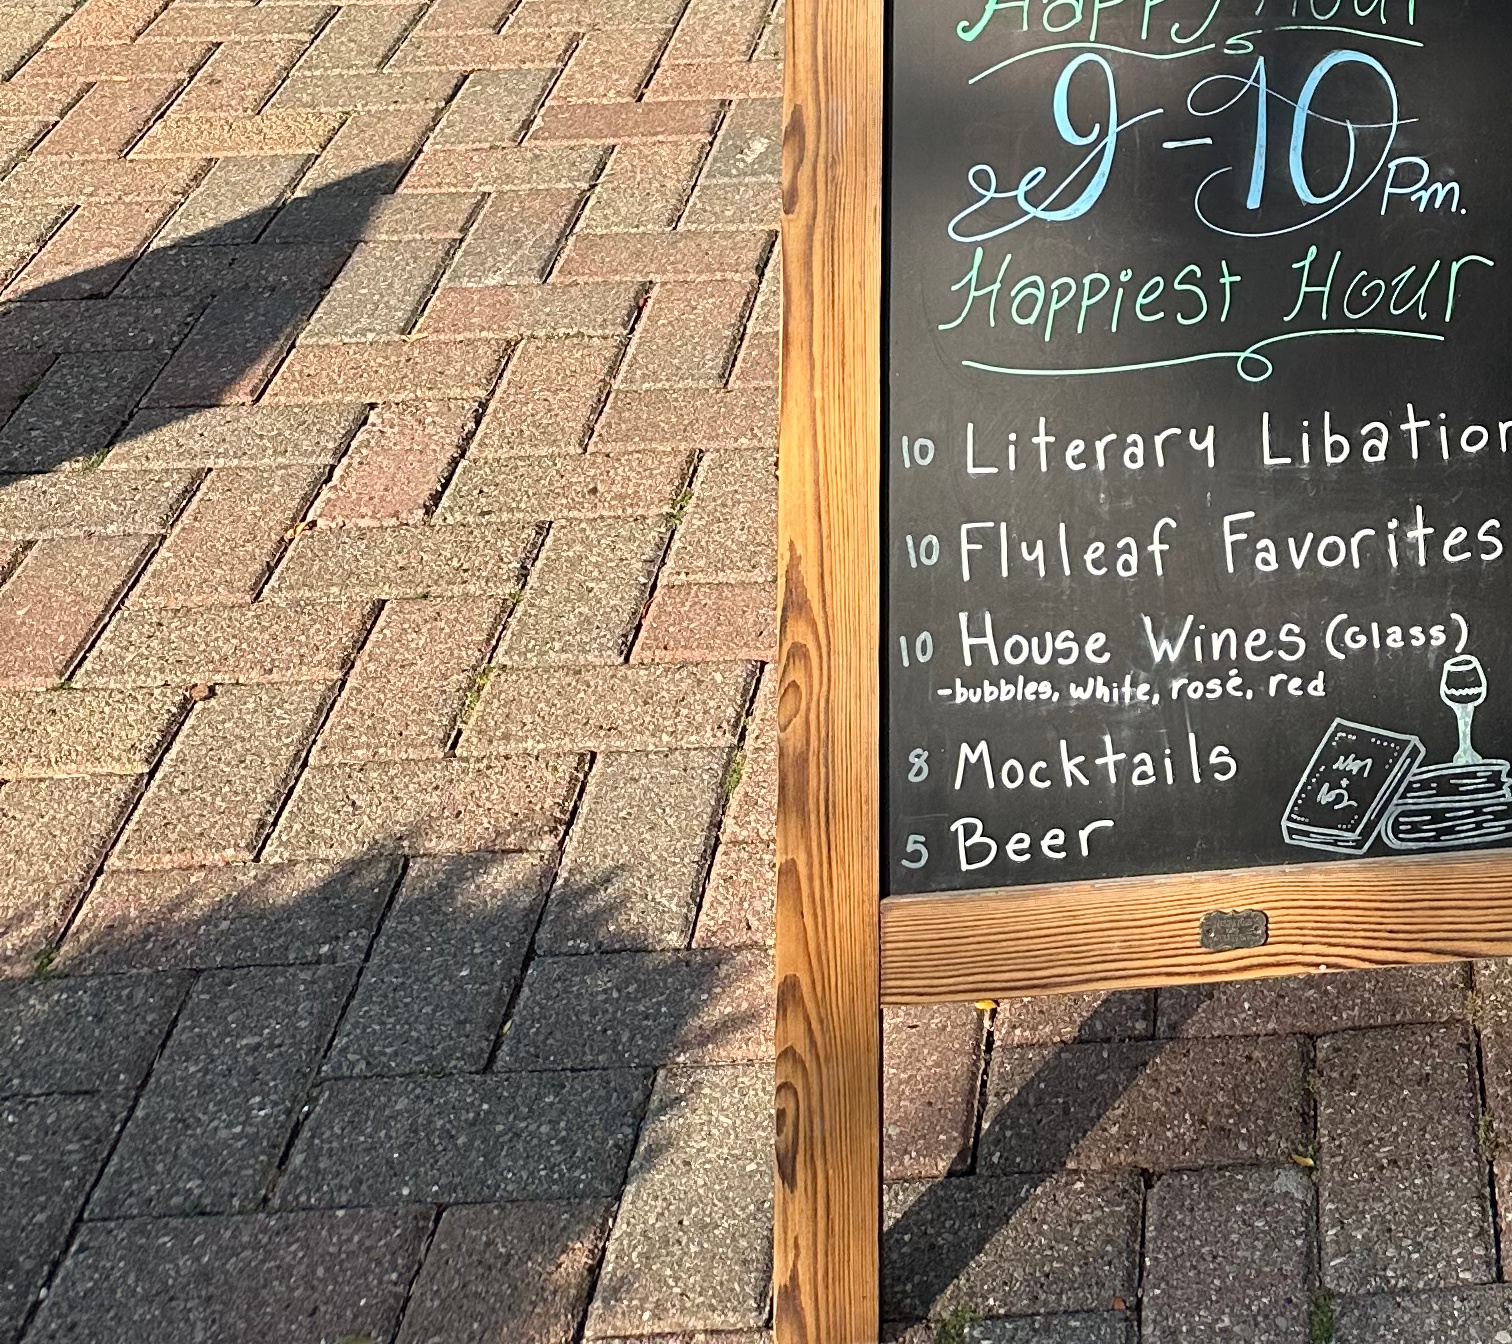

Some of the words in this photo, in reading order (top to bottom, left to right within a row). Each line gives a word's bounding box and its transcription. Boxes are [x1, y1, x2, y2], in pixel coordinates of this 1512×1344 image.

[938, 246, 1242, 342] Happiest
[1283, 244, 1495, 323] Hour
[901, 435, 935, 469] 10
[966, 416, 1216, 475] Literary
[905, 534, 940, 570] 10
[960, 516, 1178, 583] Flyleaf
[1222, 504, 1505, 575] Favorites
[899, 630, 934, 669] 10
[958, 610, 1112, 667] House
[1139, 612, 1306, 666] Wines
[1324, 612, 1469, 662] (Glass)
[1068, 670, 1161, 709] white,
[1168, 669, 1255, 704] rosé,
[1268, 670, 1326, 699] red
[907, 746, 929, 783] 8
[953, 732, 1238, 791] Mocktails
[900, 834, 929, 870] 5
[949, 816, 1115, 872] Beer
